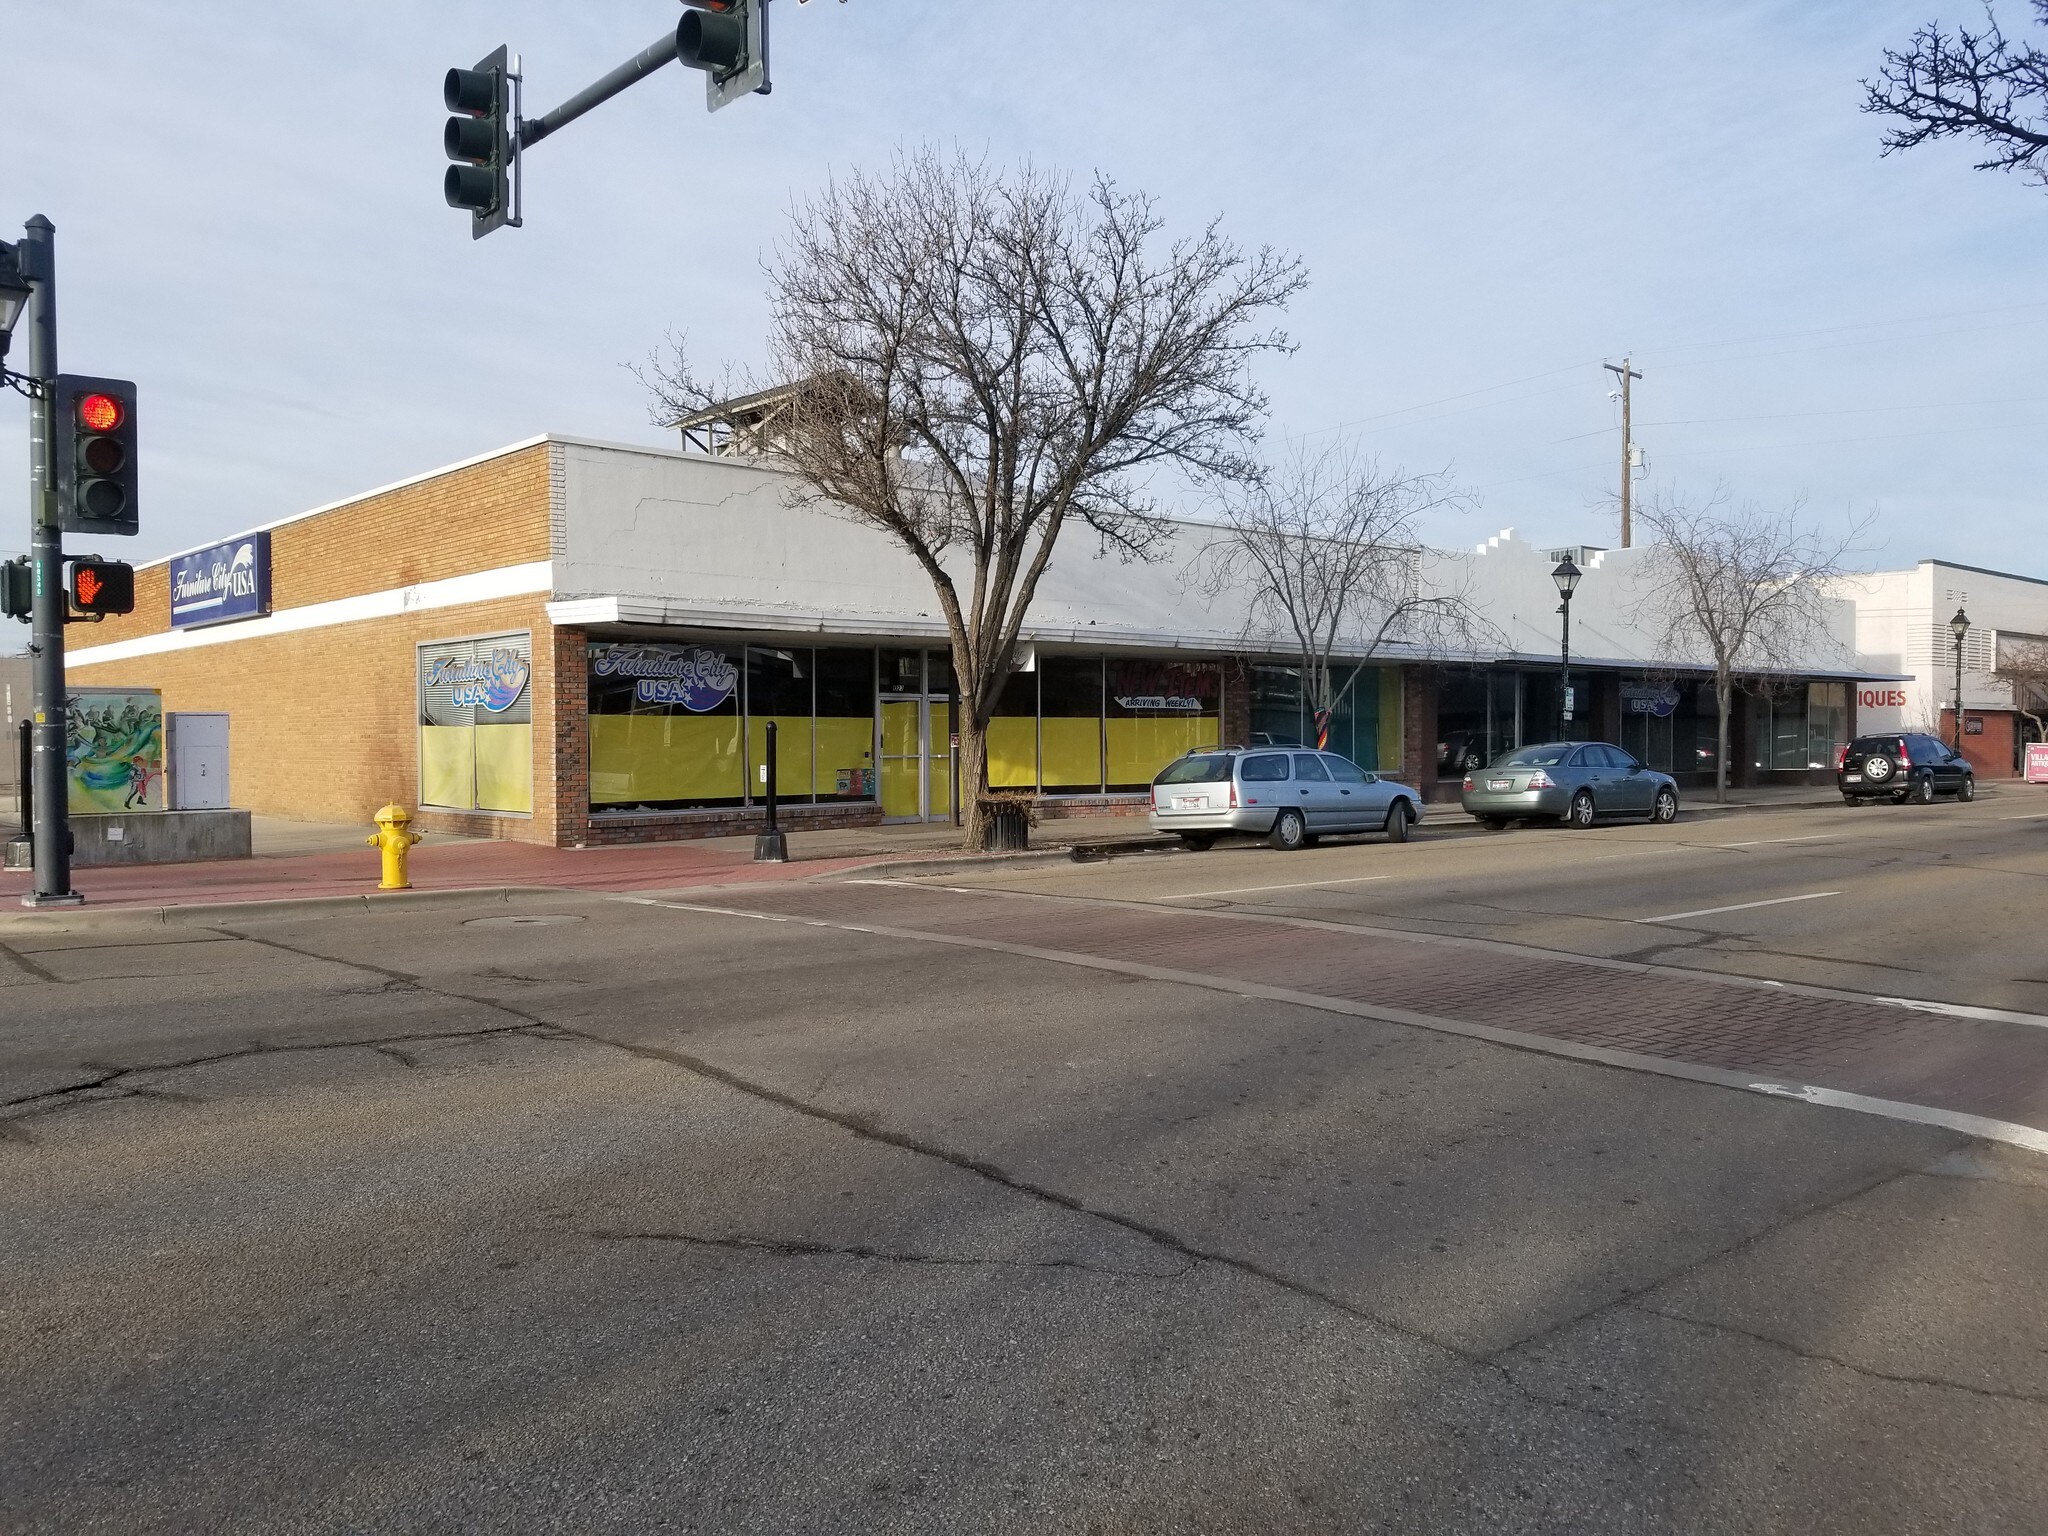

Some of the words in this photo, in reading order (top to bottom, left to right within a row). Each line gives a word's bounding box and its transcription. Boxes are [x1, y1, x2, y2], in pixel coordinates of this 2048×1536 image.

[173, 570, 211, 601] Furniture
[212, 562, 231, 601] City
[233, 569, 256, 597] USA
[595, 648, 694, 676] Furniture
[694, 649, 738, 687] City
[452, 683, 485, 707] USA
[638, 680, 684, 702] USA
[1858, 690, 1907, 708] IQUES
[1125, 699, 1160, 708] ARRIVING
[1165, 699, 1195, 708] WEEKLY!
[1632, 699, 1654, 712] USA
